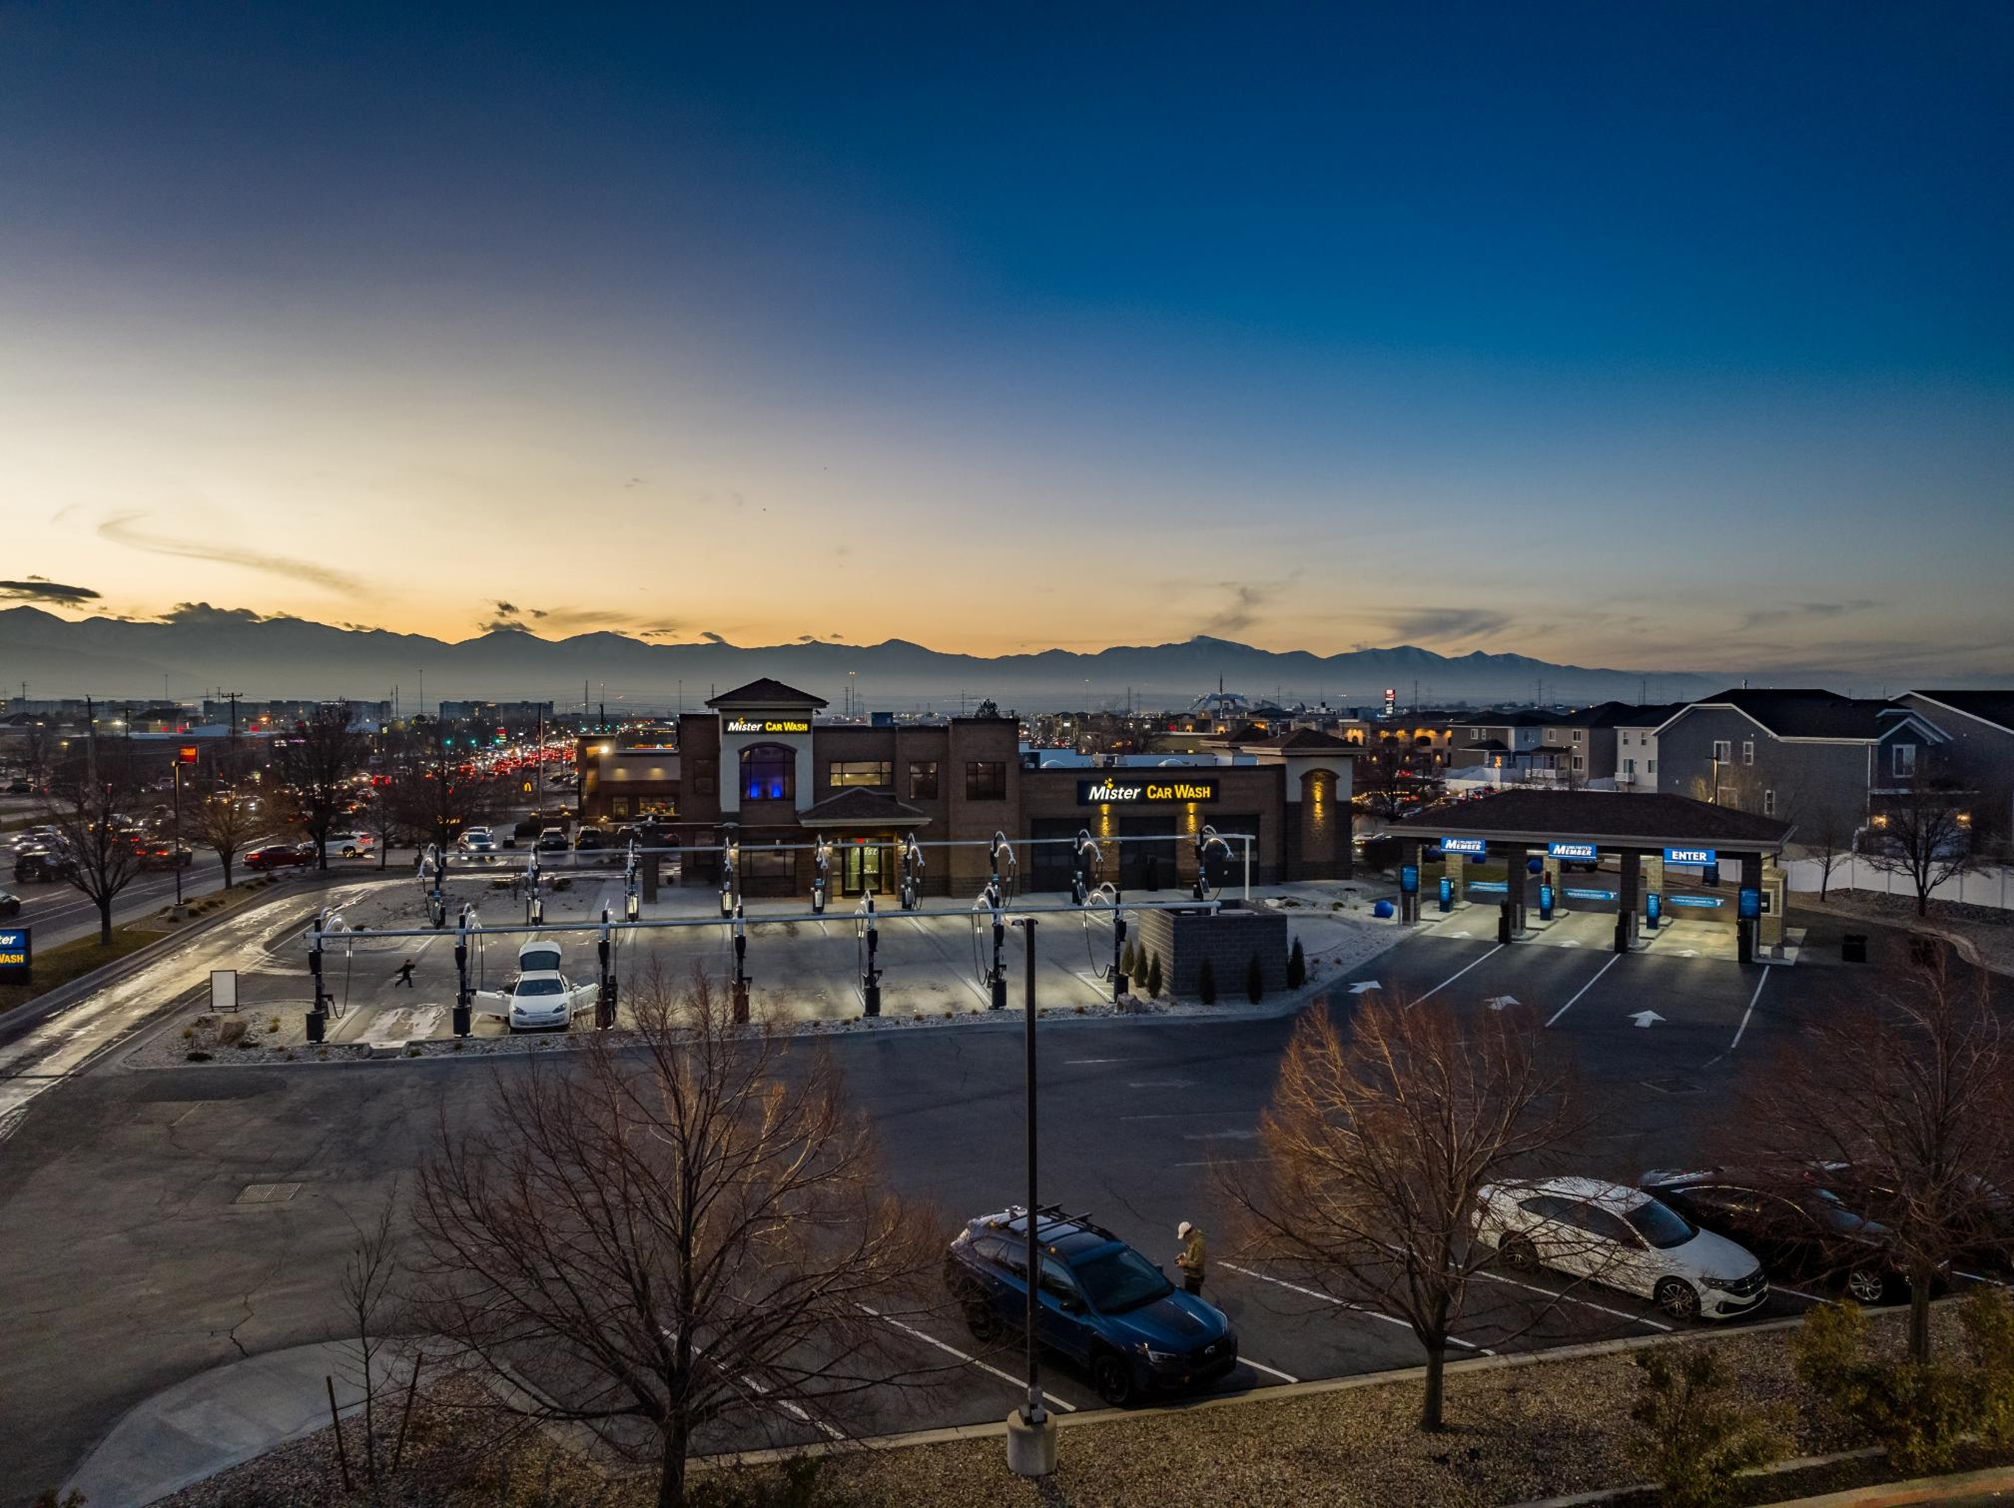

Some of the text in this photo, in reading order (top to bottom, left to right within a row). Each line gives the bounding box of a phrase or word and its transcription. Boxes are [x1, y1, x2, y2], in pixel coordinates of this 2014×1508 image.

[727, 720, 808, 732] Mister CAR WASH
[1088, 783, 1211, 800] Mister CAR WASH
[1445, 839, 1481, 851] MEMBER
[1553, 844, 1592, 856] MEMBER
[1672, 850, 1707, 861] ENTER
